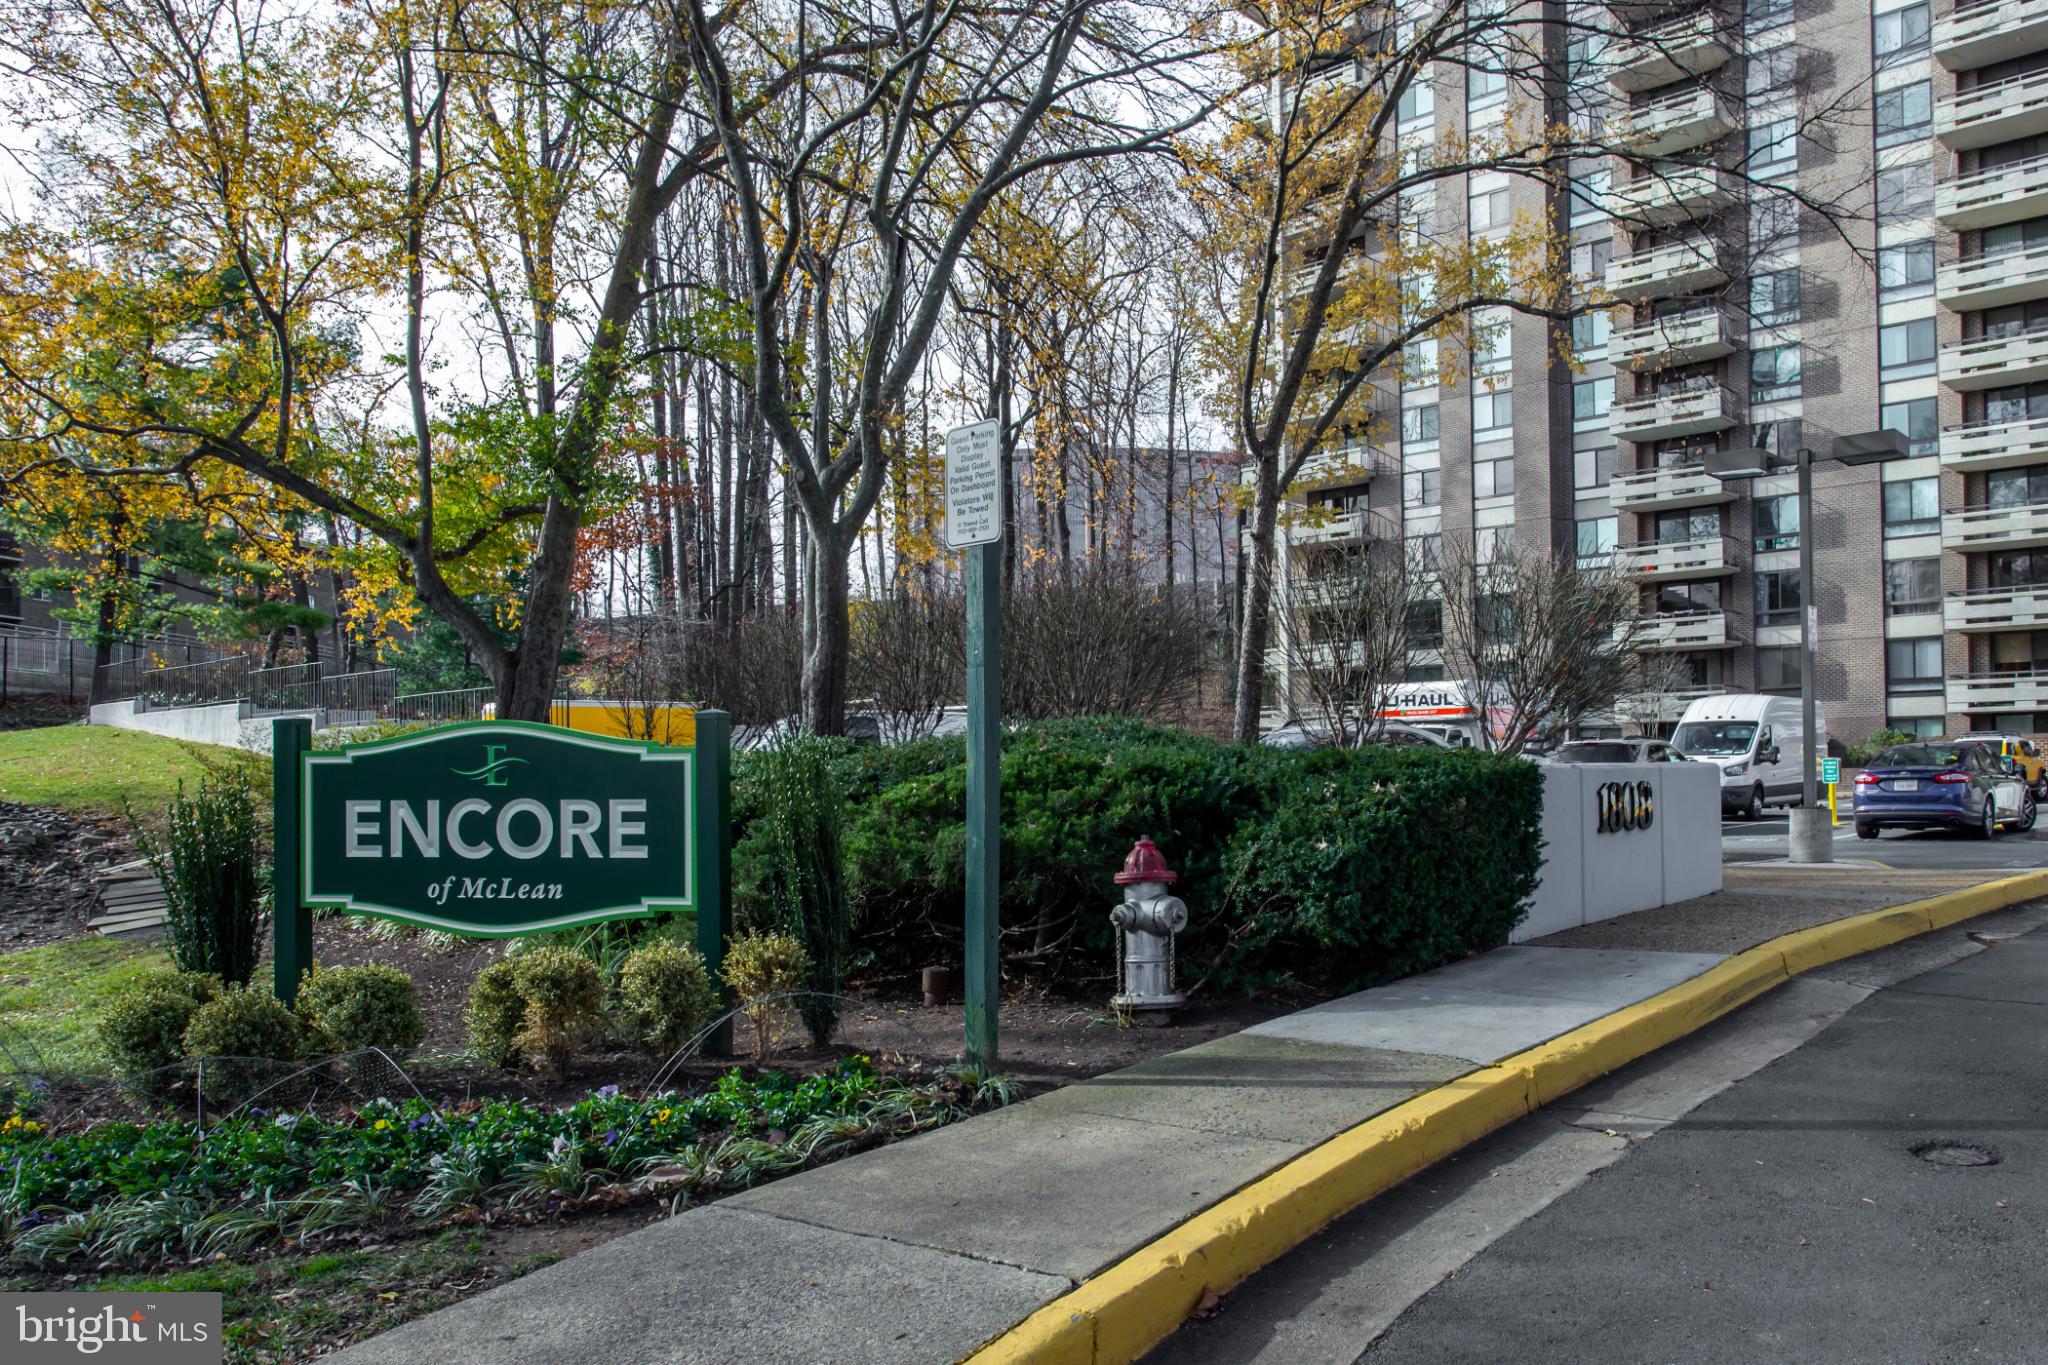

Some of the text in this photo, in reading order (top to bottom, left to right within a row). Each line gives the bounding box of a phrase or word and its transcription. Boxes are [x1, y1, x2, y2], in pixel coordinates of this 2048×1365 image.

[951, 435, 969, 445] Guest
[960, 452, 983, 463] Display
[955, 460, 990, 473] Valid Guest
[950, 469, 995, 484] Parking Permit
[961, 479, 995, 492] Dashboard
[952, 496, 980, 506] Violators
[957, 504, 988, 516] Be Towed
[345, 797, 649, 860] ENCORE
[427, 876, 564, 905] of McLean
